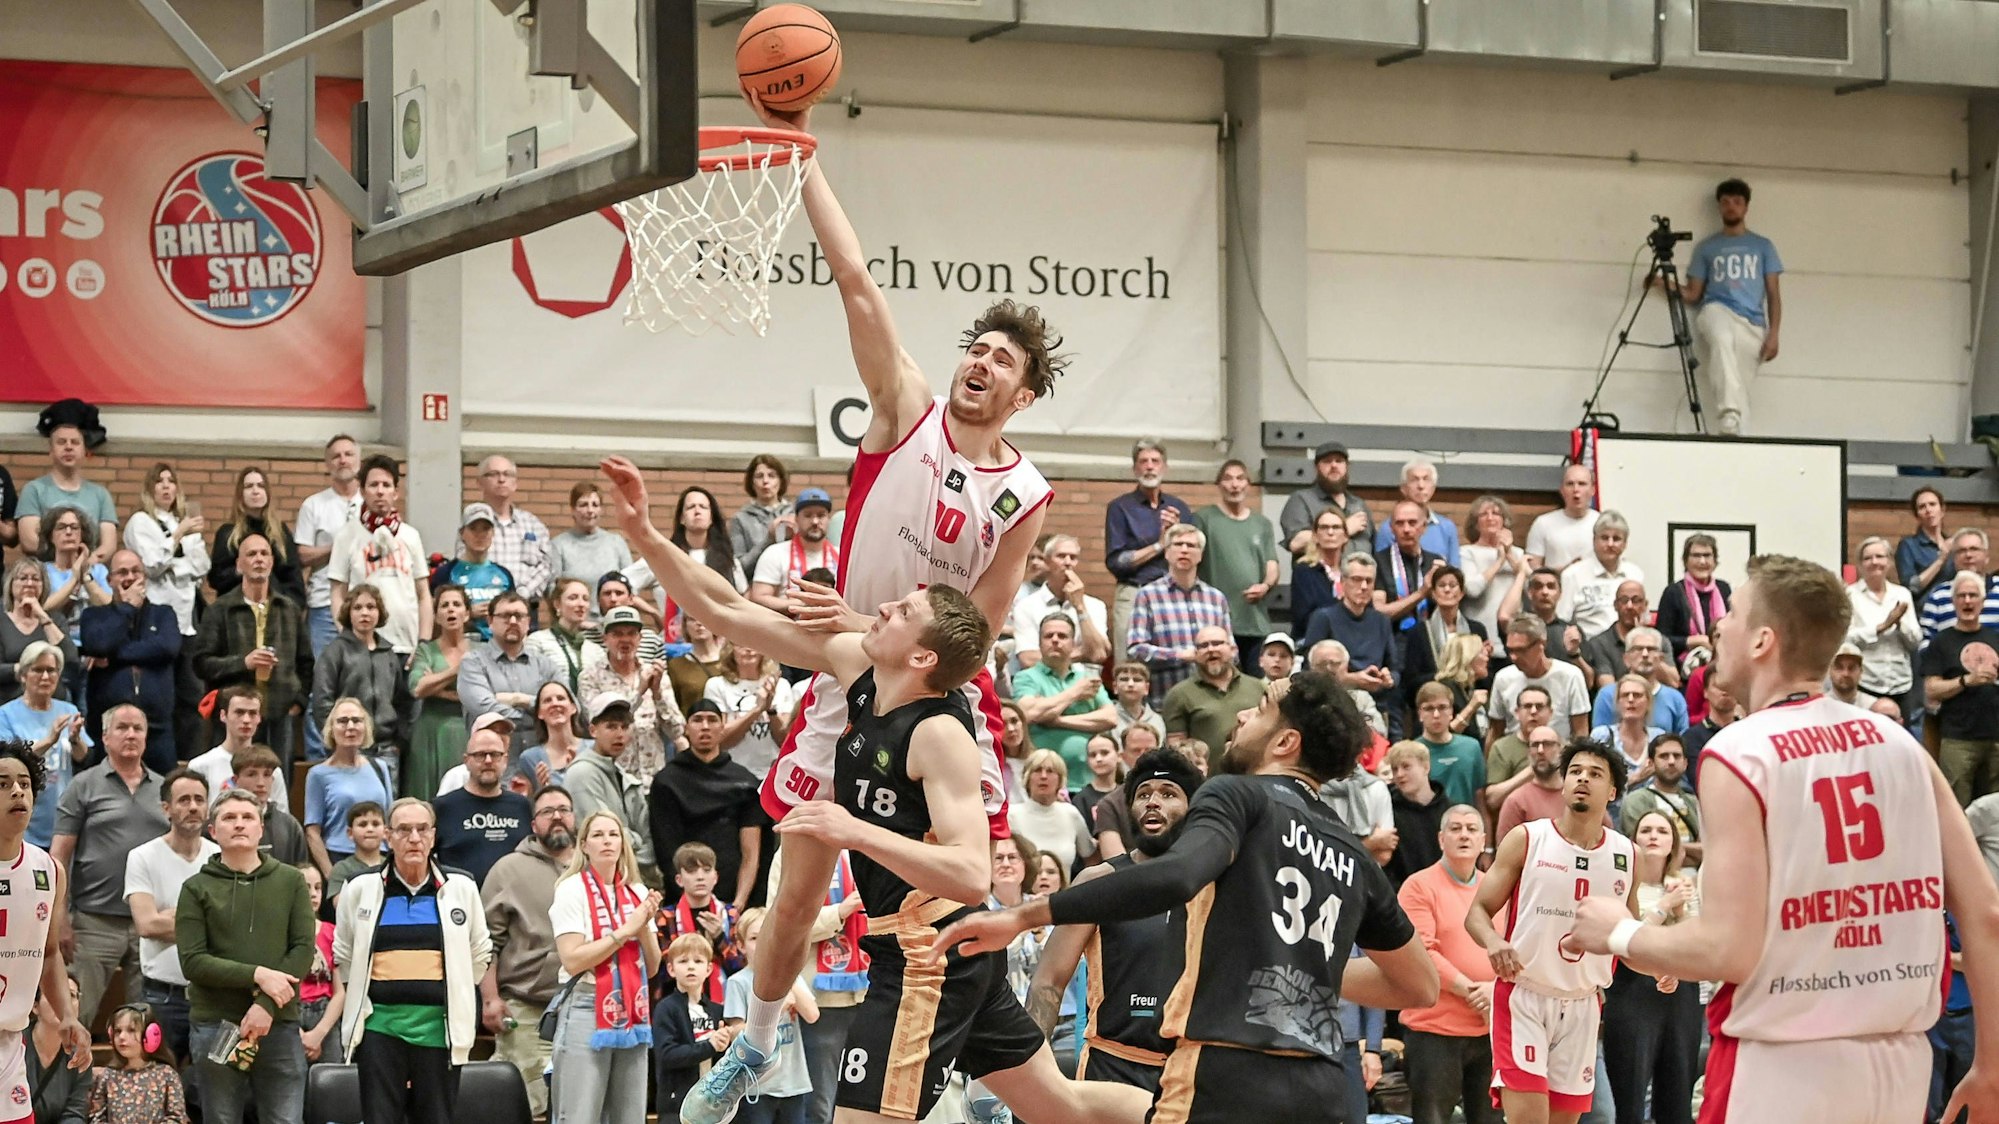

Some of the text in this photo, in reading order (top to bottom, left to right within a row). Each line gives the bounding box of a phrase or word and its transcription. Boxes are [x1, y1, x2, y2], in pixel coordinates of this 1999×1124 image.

[768, 73, 804, 95] EVO
[155, 220, 256, 258] RHEIN
[208, 253, 313, 289] STARS
[696, 239, 1170, 299] Flossbch von Storch
[1713, 254, 1758, 282] CGN
[208, 290, 248, 308] KÖLN
[1768, 719, 1885, 763] ROHWER
[785, 766, 820, 801] 90
[856, 779, 897, 817] 18
[463, 813, 519, 829] s.Oliver
[1812, 771, 1885, 865] 15
[1281, 820, 1354, 888] JONAH
[1271, 866, 1342, 962] 34
[1834, 920, 1882, 948] KÖLN
[1855, 970, 1890, 986] von
[1895, 963, 1937, 979] Storc
